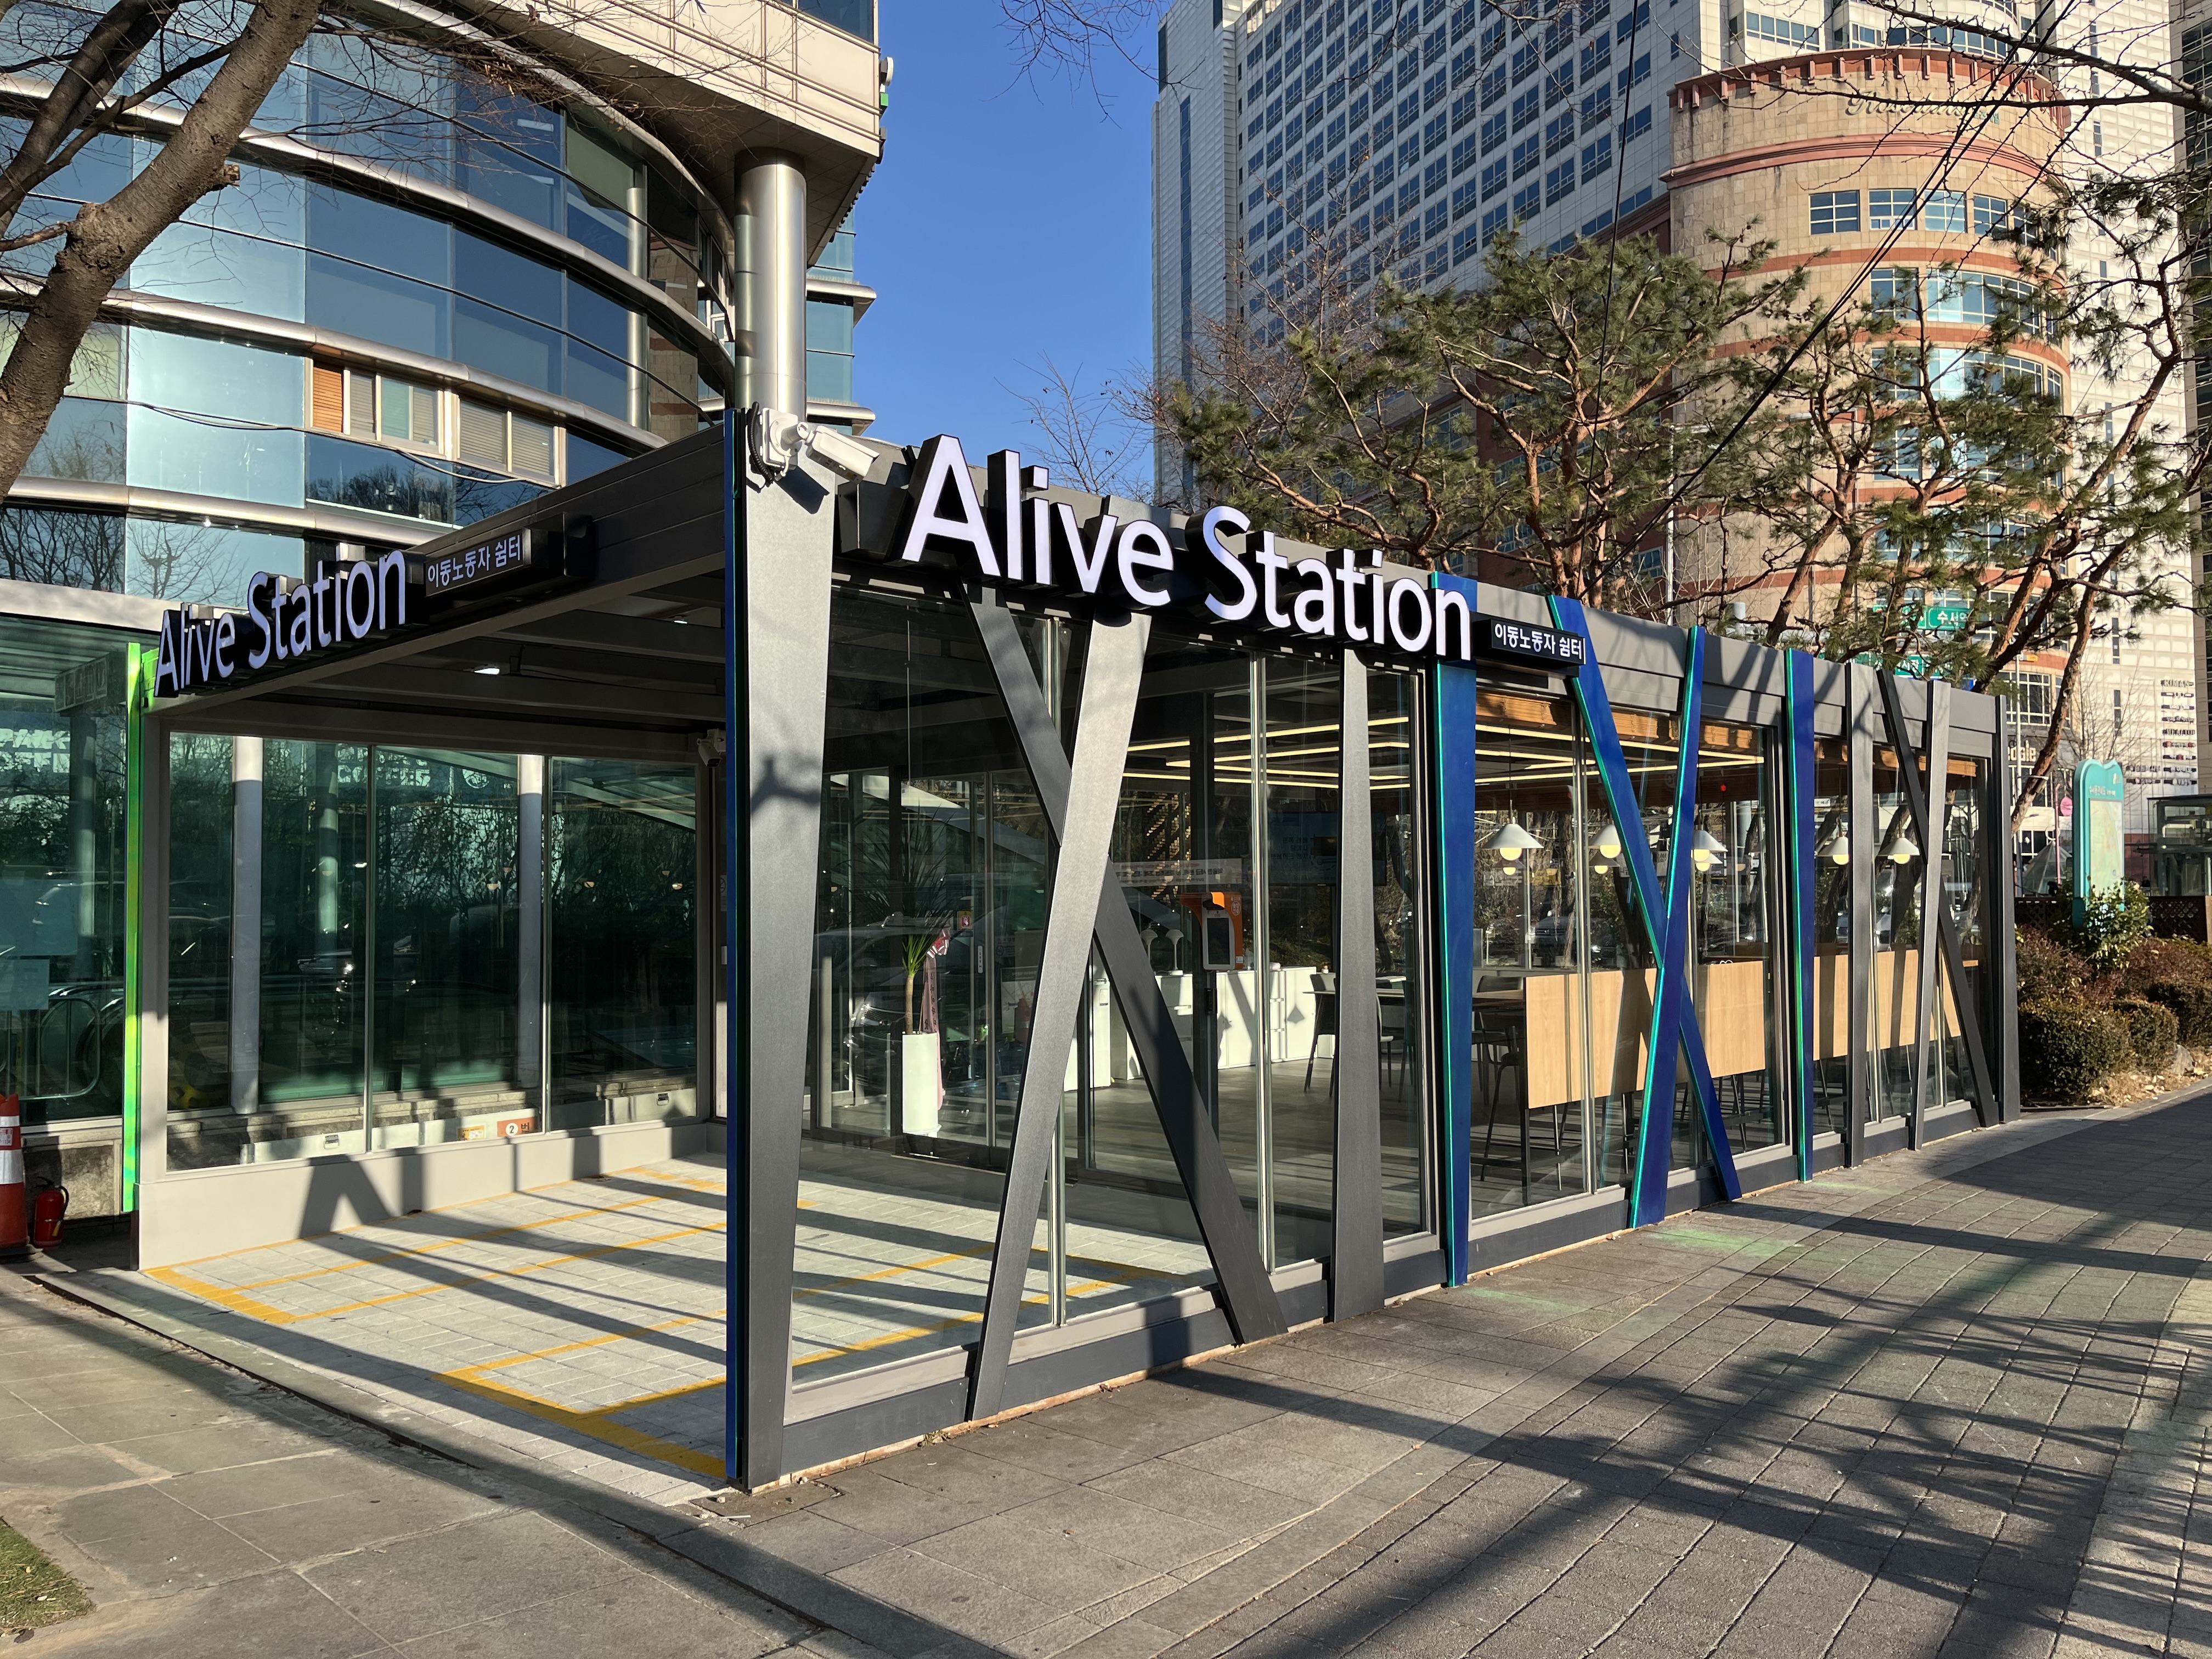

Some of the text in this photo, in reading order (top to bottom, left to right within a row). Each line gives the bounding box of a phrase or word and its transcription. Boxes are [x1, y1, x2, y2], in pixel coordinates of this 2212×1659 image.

[427, 534, 522, 589] 이동노동자 쉼터
[901, 433, 1471, 661] Alive Station
[154, 550, 406, 697] Alive Station
[1494, 623, 1582, 659] 이동노동자 쉼터
[509, 1125, 515, 1134] 2
